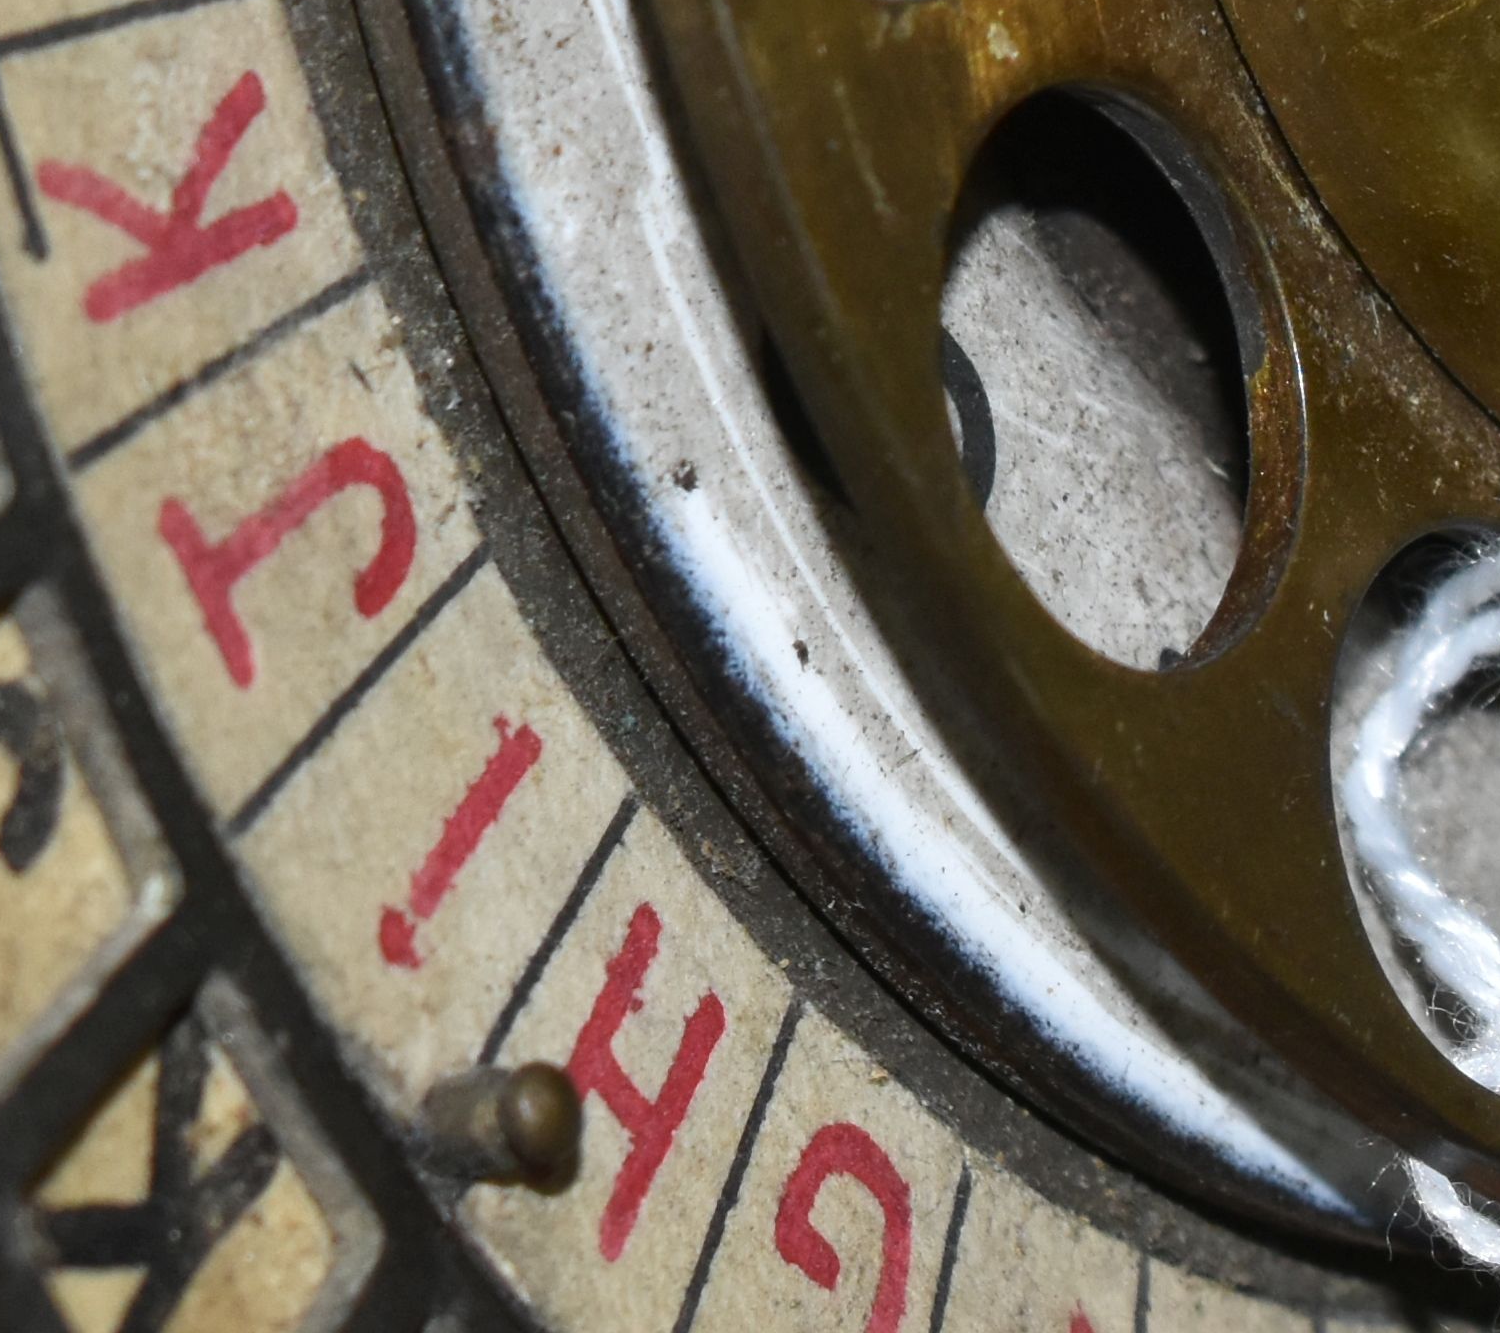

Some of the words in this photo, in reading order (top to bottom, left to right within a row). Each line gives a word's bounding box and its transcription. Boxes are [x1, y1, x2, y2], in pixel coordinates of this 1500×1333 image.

[36, 70, 300, 324] K
[158, 435, 418, 689] J
[564, 903, 728, 1263] H
